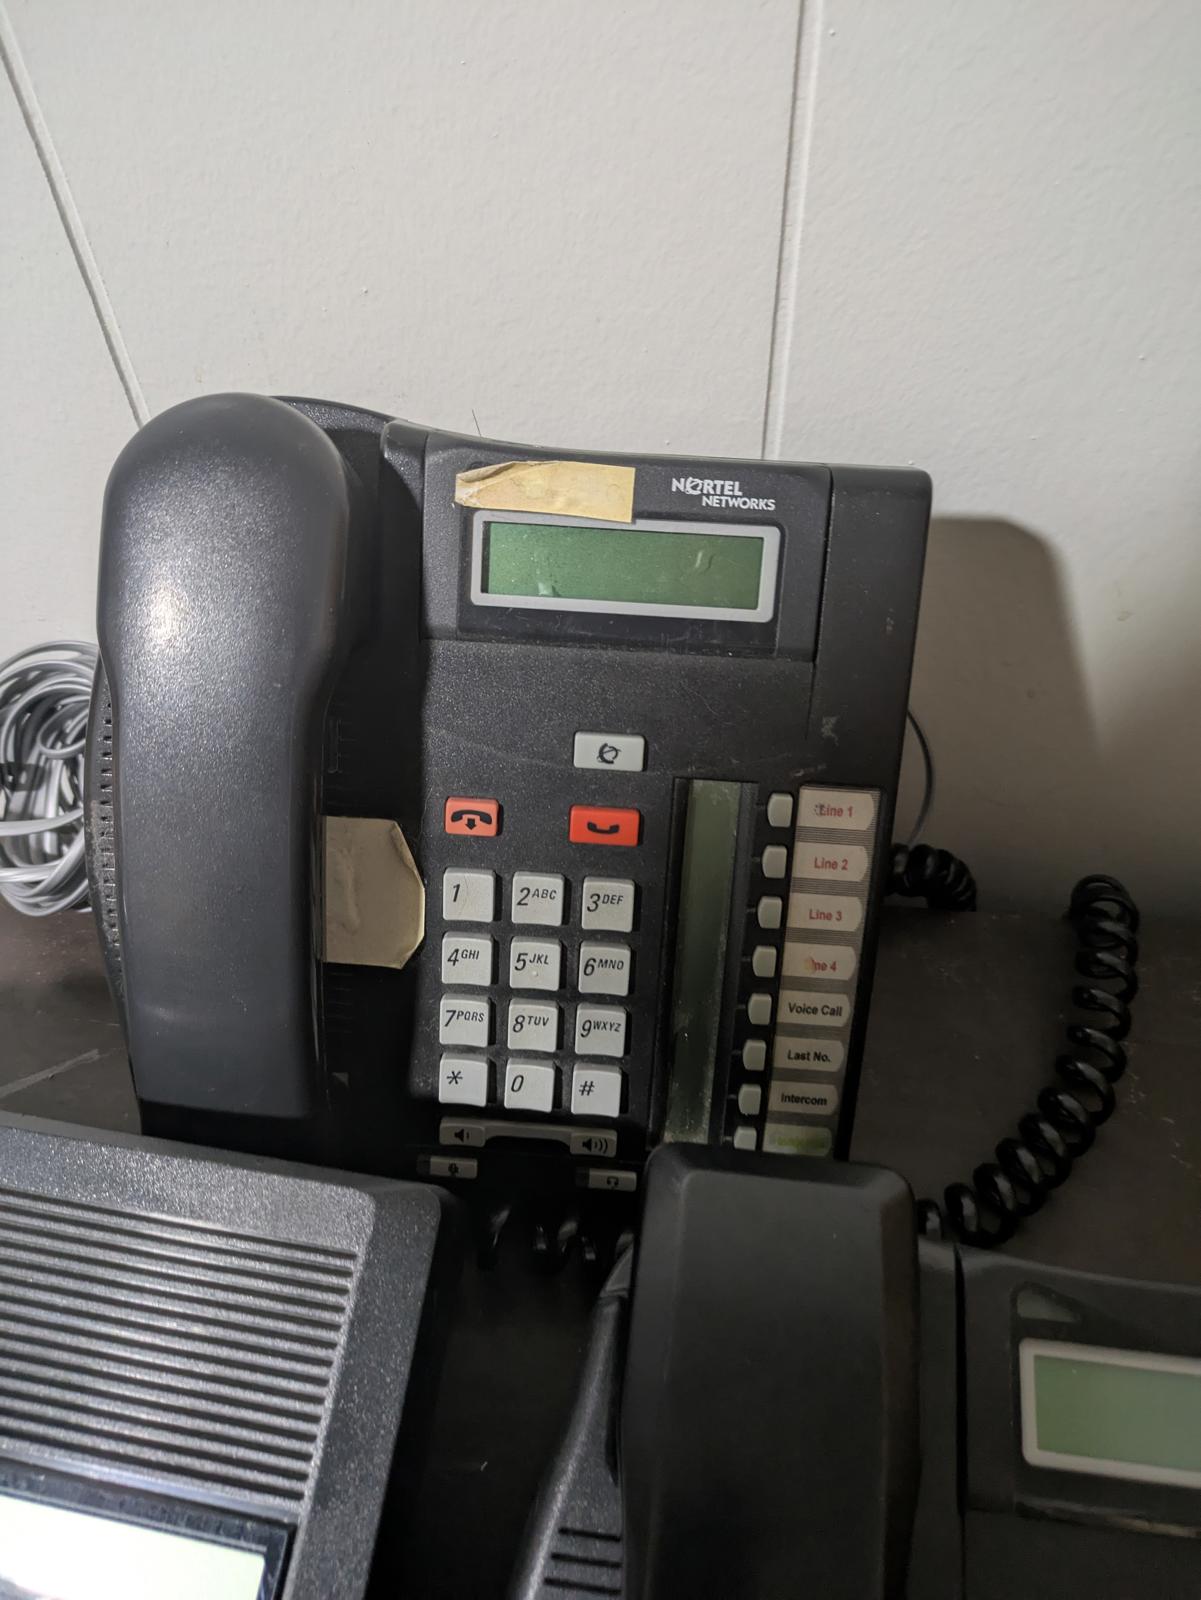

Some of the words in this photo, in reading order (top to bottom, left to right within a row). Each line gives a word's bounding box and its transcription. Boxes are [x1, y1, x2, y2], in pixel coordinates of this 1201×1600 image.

[671, 476, 743, 496] NORTEL
[701, 495, 776, 511] NETWORKS
[847, 805, 853, 817] 1
[814, 857, 838, 871] Line
[841, 858, 849, 871] 2
[452, 883, 460, 903] 1
[809, 909, 832, 921] Line
[835, 910, 843, 922] 3
[830, 960, 837, 972] 4
[788, 1002, 819, 1015] Voice
[821, 1004, 843, 1017] Call
[787, 1049, 811, 1062] Last
[812, 1051, 831, 1063] No.
[780, 1093, 828, 1106] Intercom
